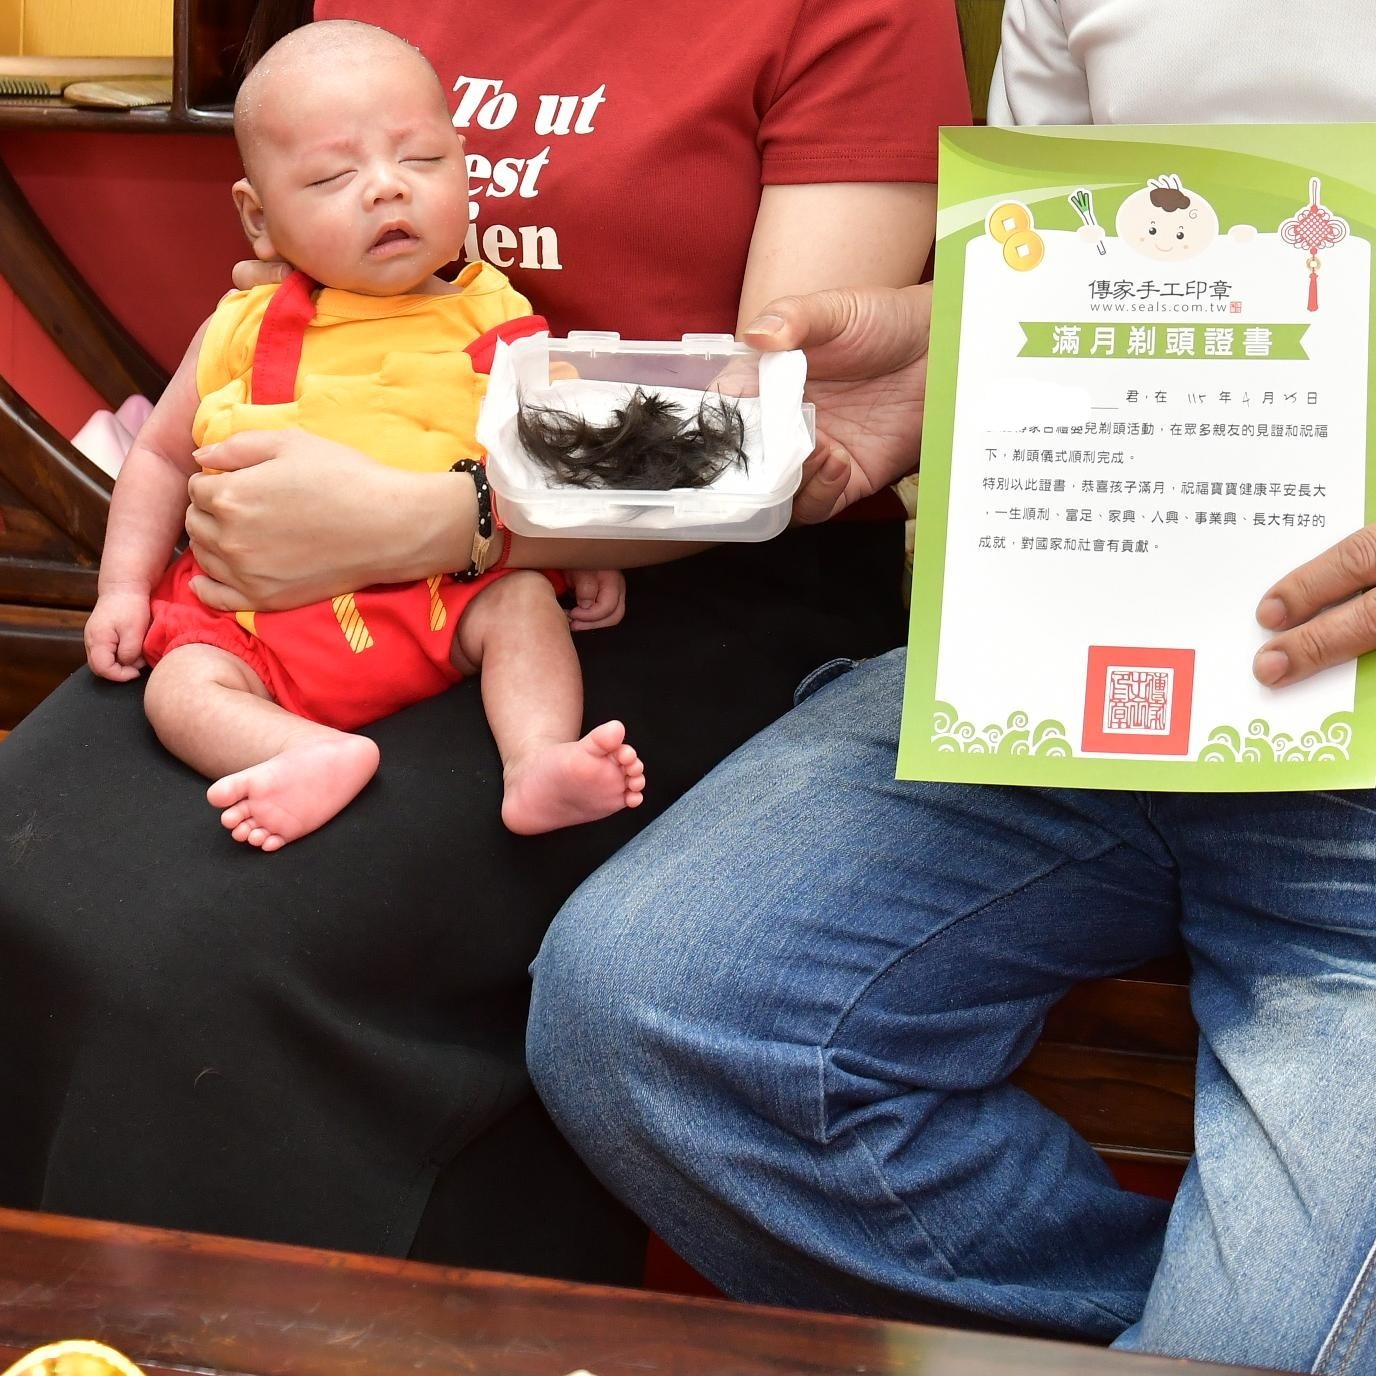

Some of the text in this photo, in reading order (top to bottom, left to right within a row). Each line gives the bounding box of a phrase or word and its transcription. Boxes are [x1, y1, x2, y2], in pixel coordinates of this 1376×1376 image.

[1088, 279, 1233, 300] 傳家手工印章
[1090, 301, 1227, 313] www.seals.com.tw
[1051, 325, 1273, 356] 滿月剃頭證書
[1219, 390, 1232, 405] 年
[1262, 391, 1274, 405] 月
[1307, 391, 1318, 405] 日
